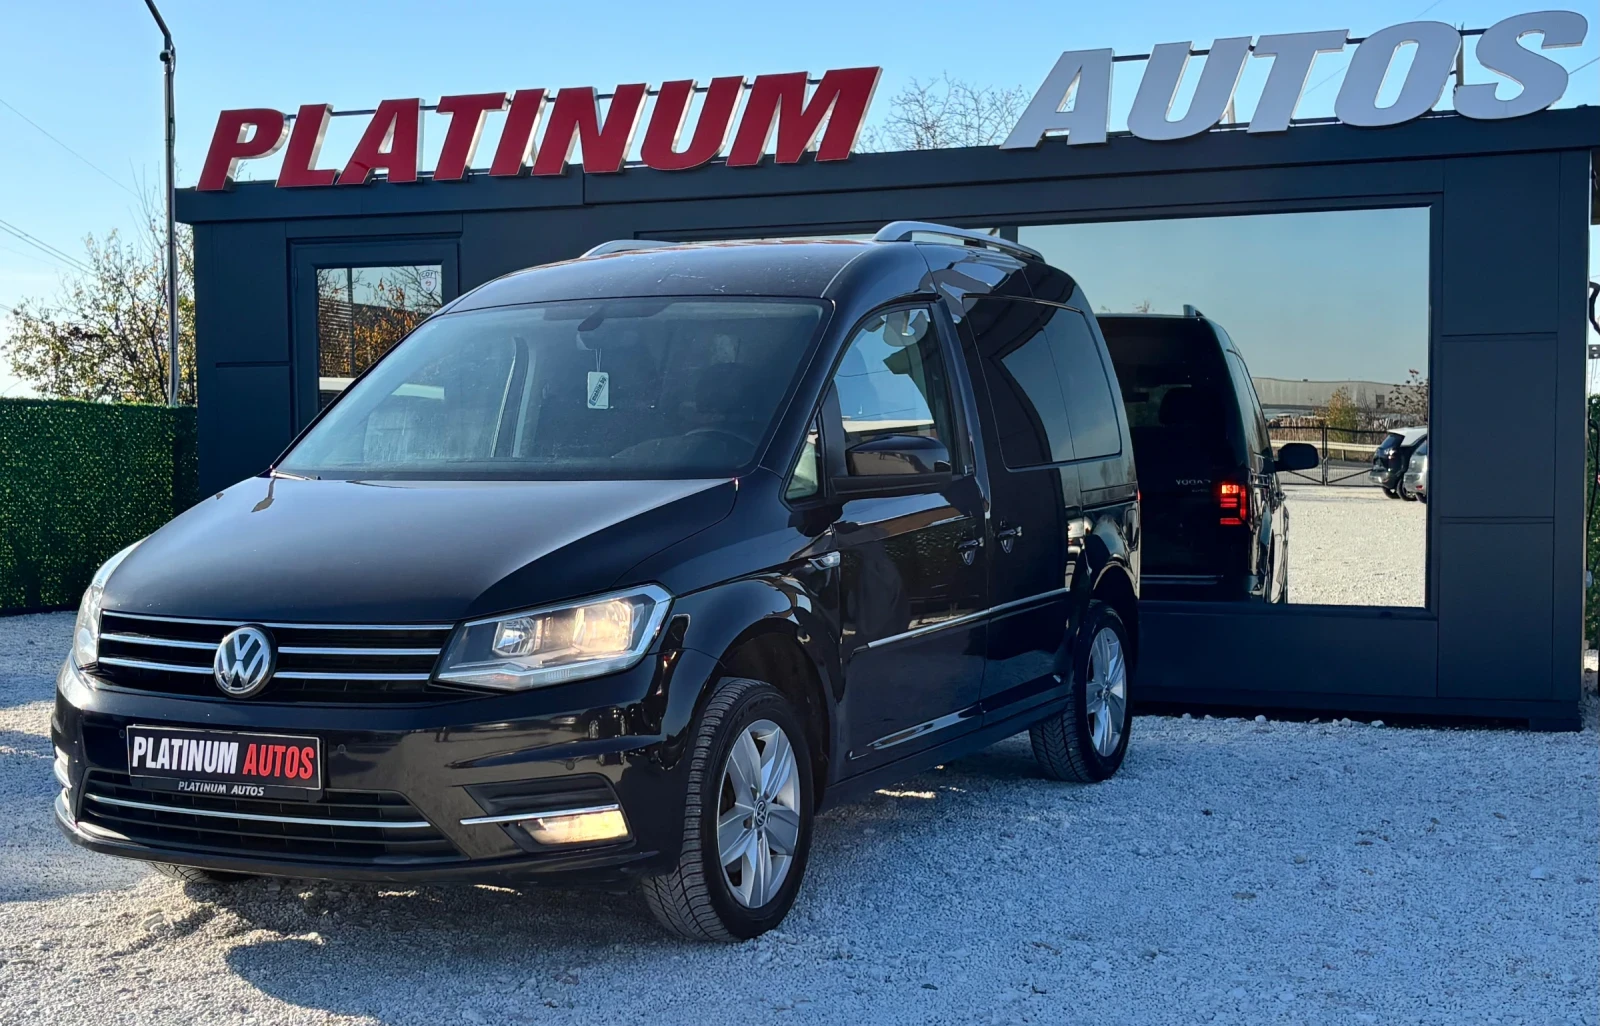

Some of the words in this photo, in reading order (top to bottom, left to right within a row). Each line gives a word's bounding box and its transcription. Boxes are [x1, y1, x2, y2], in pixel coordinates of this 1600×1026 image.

[196, 66, 882, 191] PLATINUM
[999, 10, 1588, 149] AUTOS
[132, 736, 239, 774] PLATINUM
[242, 743, 315, 779] AUTOS
[178, 781, 227, 794] PLATINUM
[231, 786, 265, 797] AUTOS
